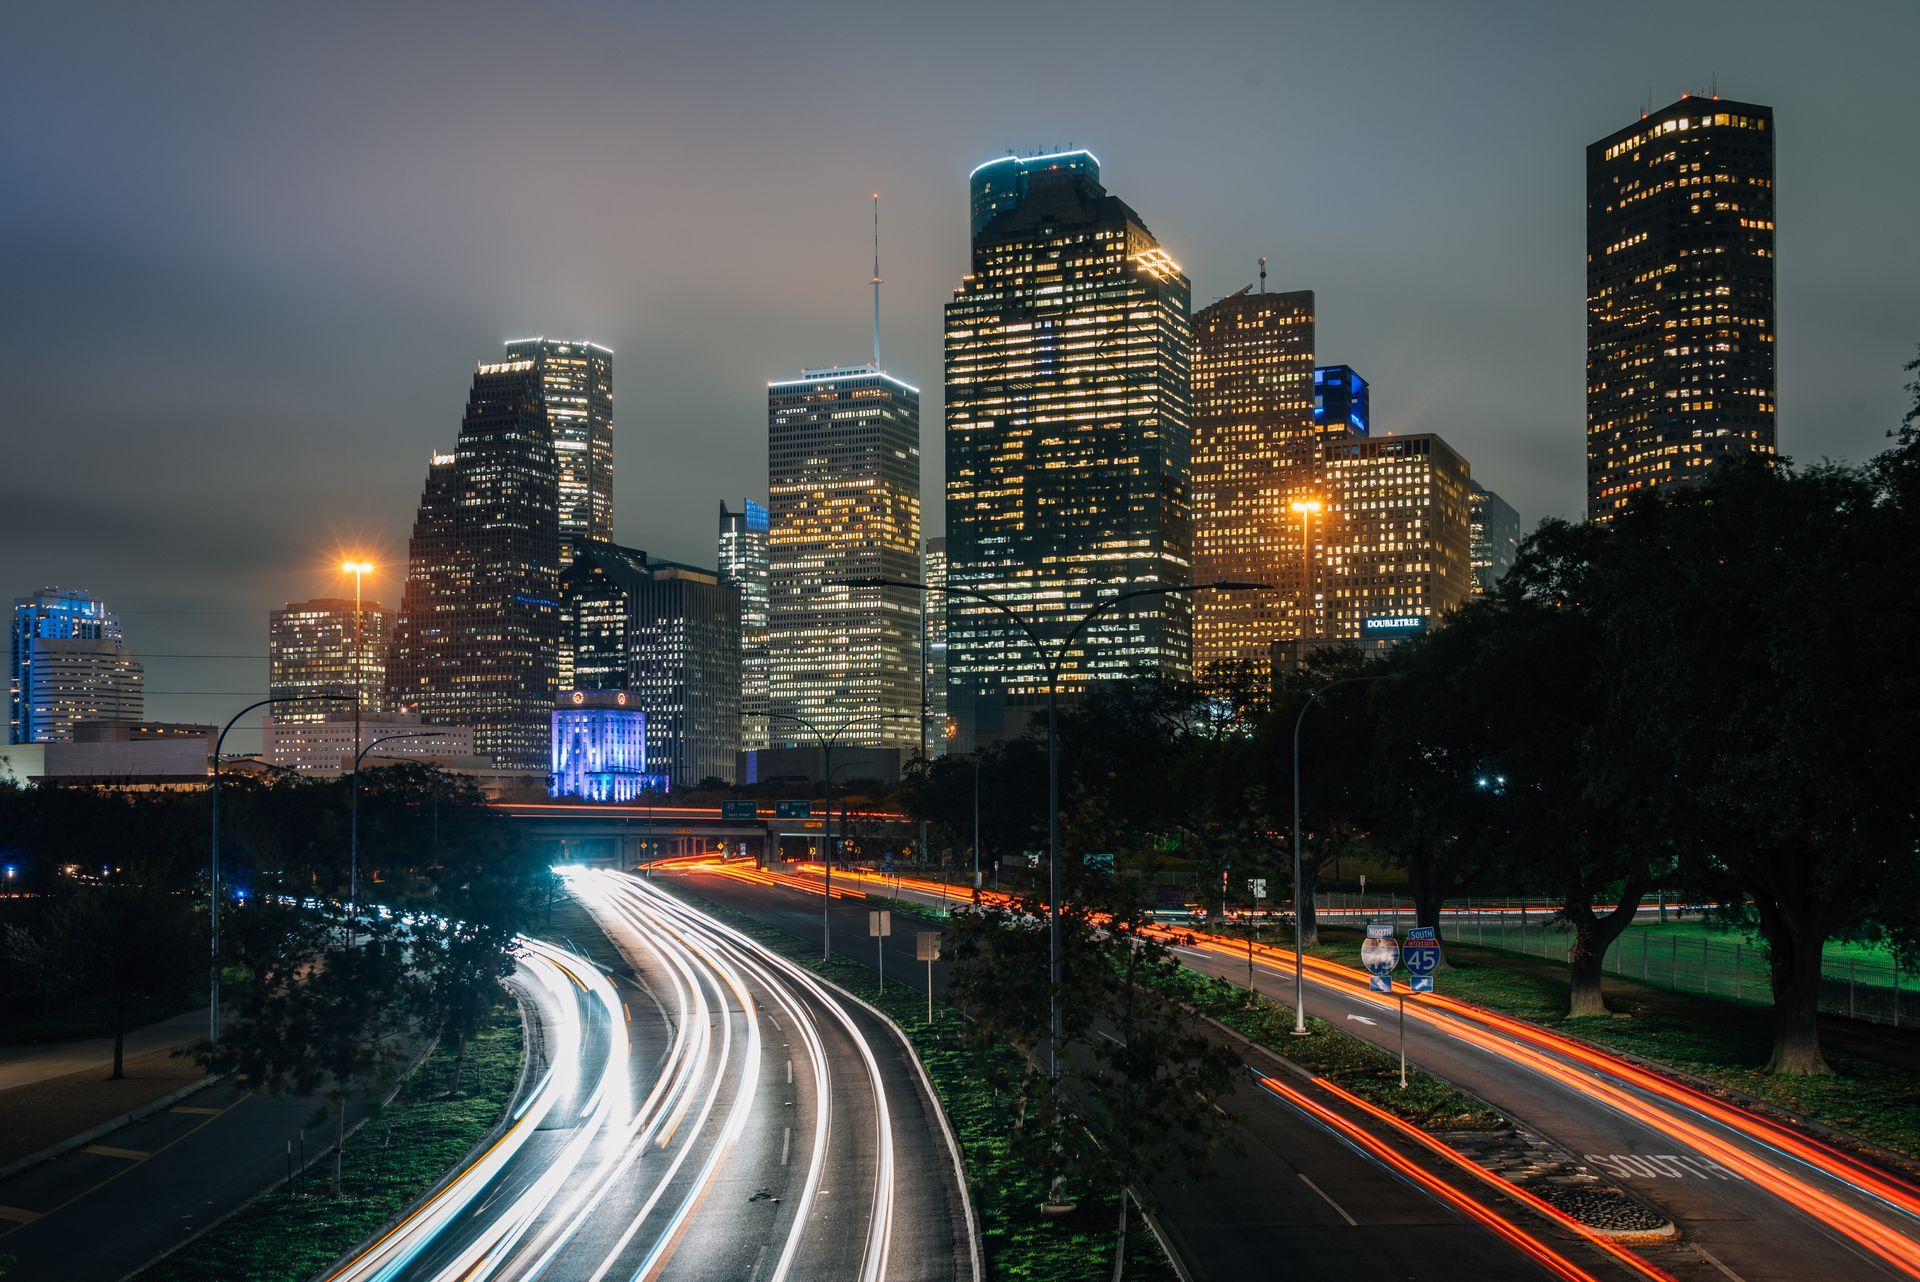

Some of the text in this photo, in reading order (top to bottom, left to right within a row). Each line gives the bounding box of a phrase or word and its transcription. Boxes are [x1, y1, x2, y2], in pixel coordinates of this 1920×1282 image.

[1367, 618, 1420, 628] DOUBLETREE
[1369, 928, 1392, 936] NORTH
[1410, 931, 1433, 940] SOUTH
[1407, 950, 1436, 970] 45
[1583, 1154, 1745, 1180] SOUTH
